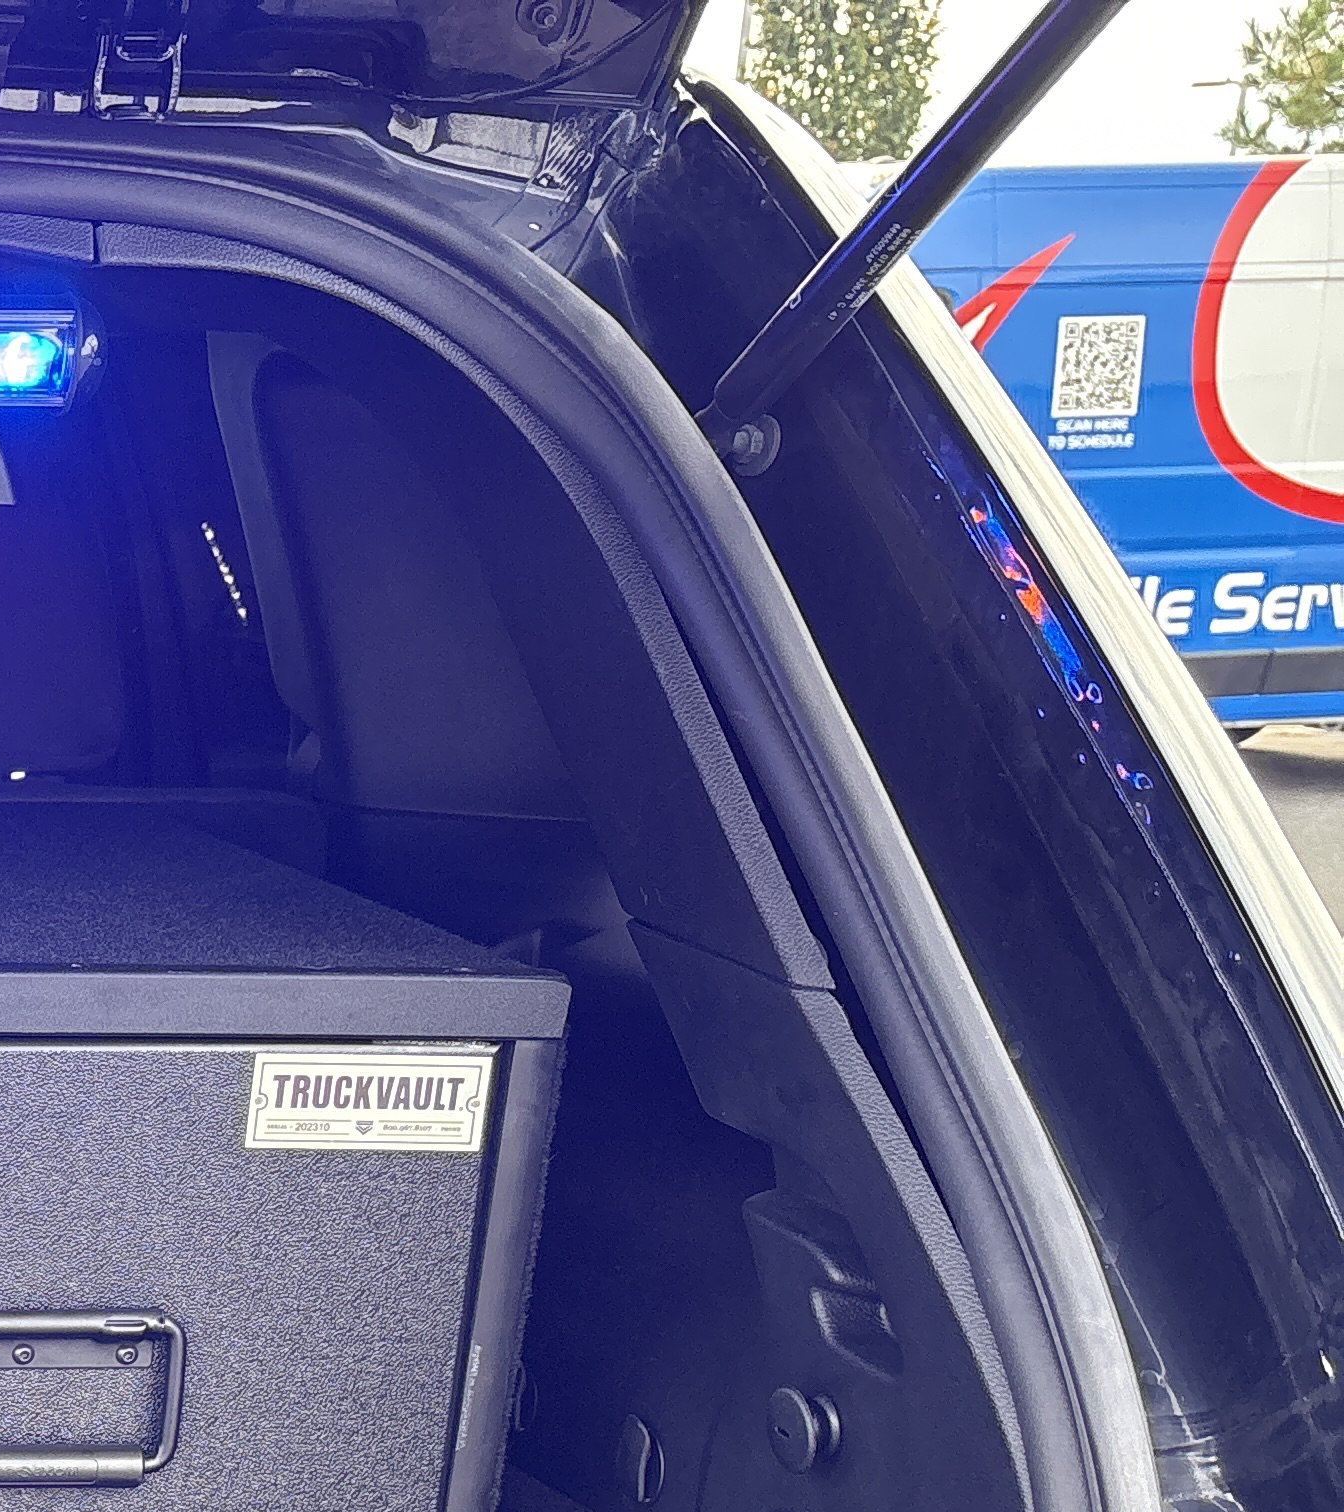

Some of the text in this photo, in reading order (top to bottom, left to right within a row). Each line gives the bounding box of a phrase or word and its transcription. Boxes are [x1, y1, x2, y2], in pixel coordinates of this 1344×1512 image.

[1047, 432, 1135, 451] TO SCHEDULE
[273, 1074, 465, 1112] TRUCKVAULT
